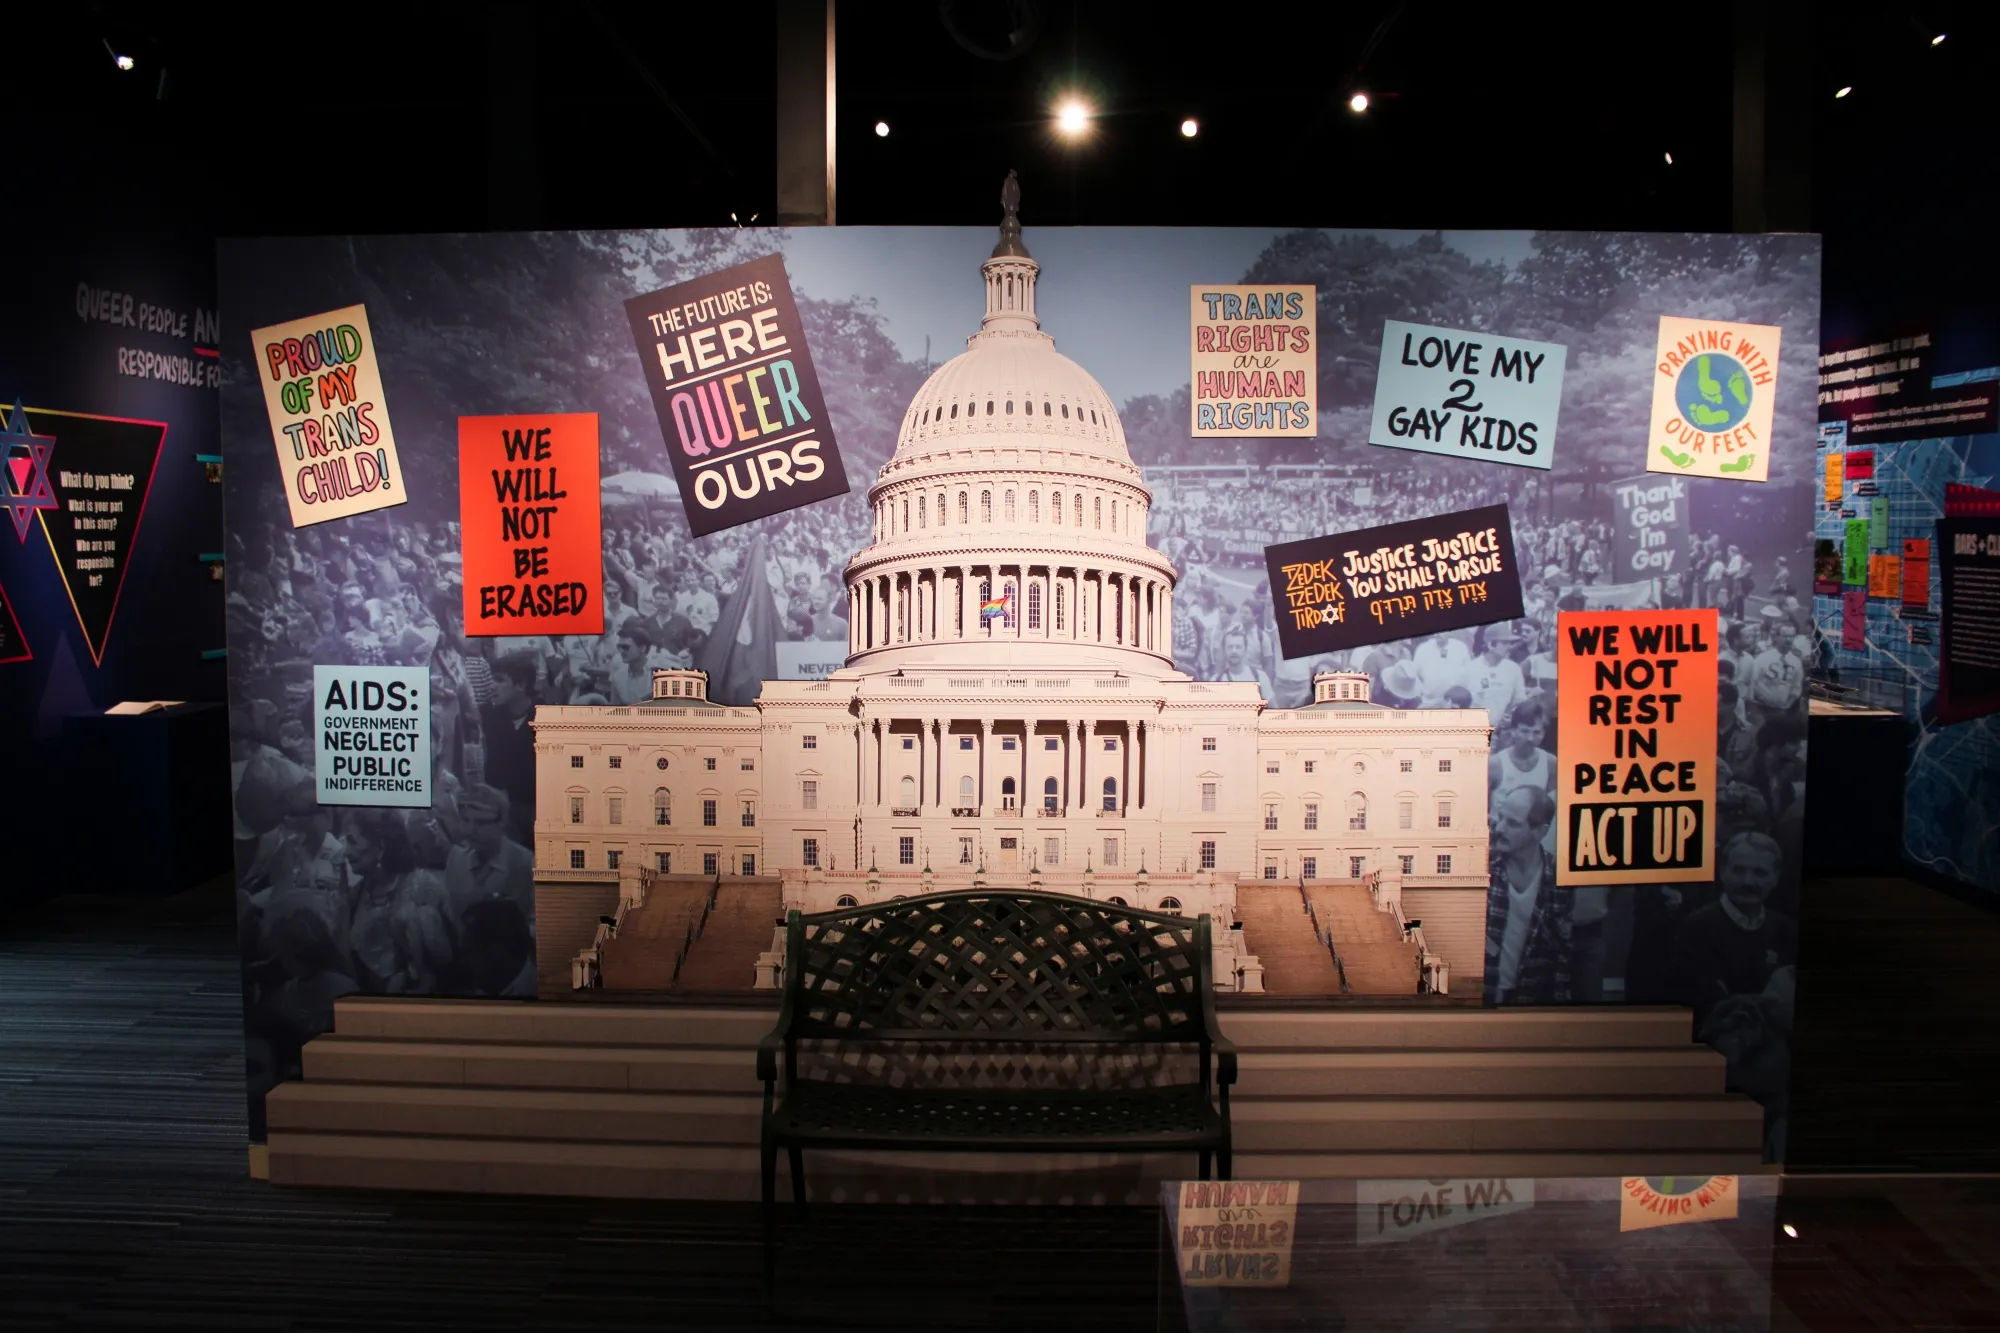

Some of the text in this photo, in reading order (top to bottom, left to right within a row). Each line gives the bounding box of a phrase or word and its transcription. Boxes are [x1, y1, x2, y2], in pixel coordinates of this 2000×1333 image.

[76, 281, 220, 344] QUEER PEOPLE AN
[648, 281, 773, 336] THE FUTURE IS:
[1202, 292, 1303, 321] TRANS
[266, 324, 362, 381] PROUD
[656, 308, 787, 381] HERE
[1197, 325, 1310, 354] RIGHTS
[118, 346, 220, 388] RESPONSIBLE FO
[1233, 352, 1280, 370] are
[1401, 332, 1544, 384] LOVE MY
[1658, 330, 1773, 387] PRAYING WITH
[281, 364, 357, 414] OF MY
[1197, 370, 1306, 399] HUMAN
[1442, 379, 1483, 413] 2
[671, 359, 812, 456] QUEER
[1198, 401, 1310, 430] RIGHTS
[283, 402, 379, 460] TRANS
[502, 428, 551, 461] WE
[1388, 406, 1538, 457] GAY KIDS
[1665, 418, 1758, 455] OUR FEET
[60, 471, 134, 491] What do you think?
[297, 448, 390, 504] CHILD!
[492, 467, 567, 503] WILL
[695, 439, 825, 509] OURS
[1616, 477, 1684, 509] Thank
[502, 506, 557, 542] NOT
[1631, 501, 1676, 528] God
[514, 546, 548, 578] BE
[1342, 527, 1499, 578] JUSTICE JUSTICE
[1631, 549, 1676, 571] Gay
[1281, 558, 1338, 591] TZEDEK
[1347, 553, 1503, 599] YOU SHALL PURSUE
[480, 582, 587, 619] ERASED
[1286, 582, 1344, 607] TZEDEK
[1568, 624, 1708, 656] WE WILL
[1595, 659, 1678, 691] NOT
[325, 679, 418, 711] AIDS:
[1590, 694, 1682, 726] REST
[324, 716, 418, 730] GOVERNMENT
[324, 731, 419, 752] NEGLECT
[1615, 728, 1657, 758] IN
[334, 756, 411, 777] PUBLIC
[1575, 761, 1696, 795] PEACE
[325, 778, 422, 792] INDIFFERENCE
[1575, 806, 1697, 866] ACT UP
